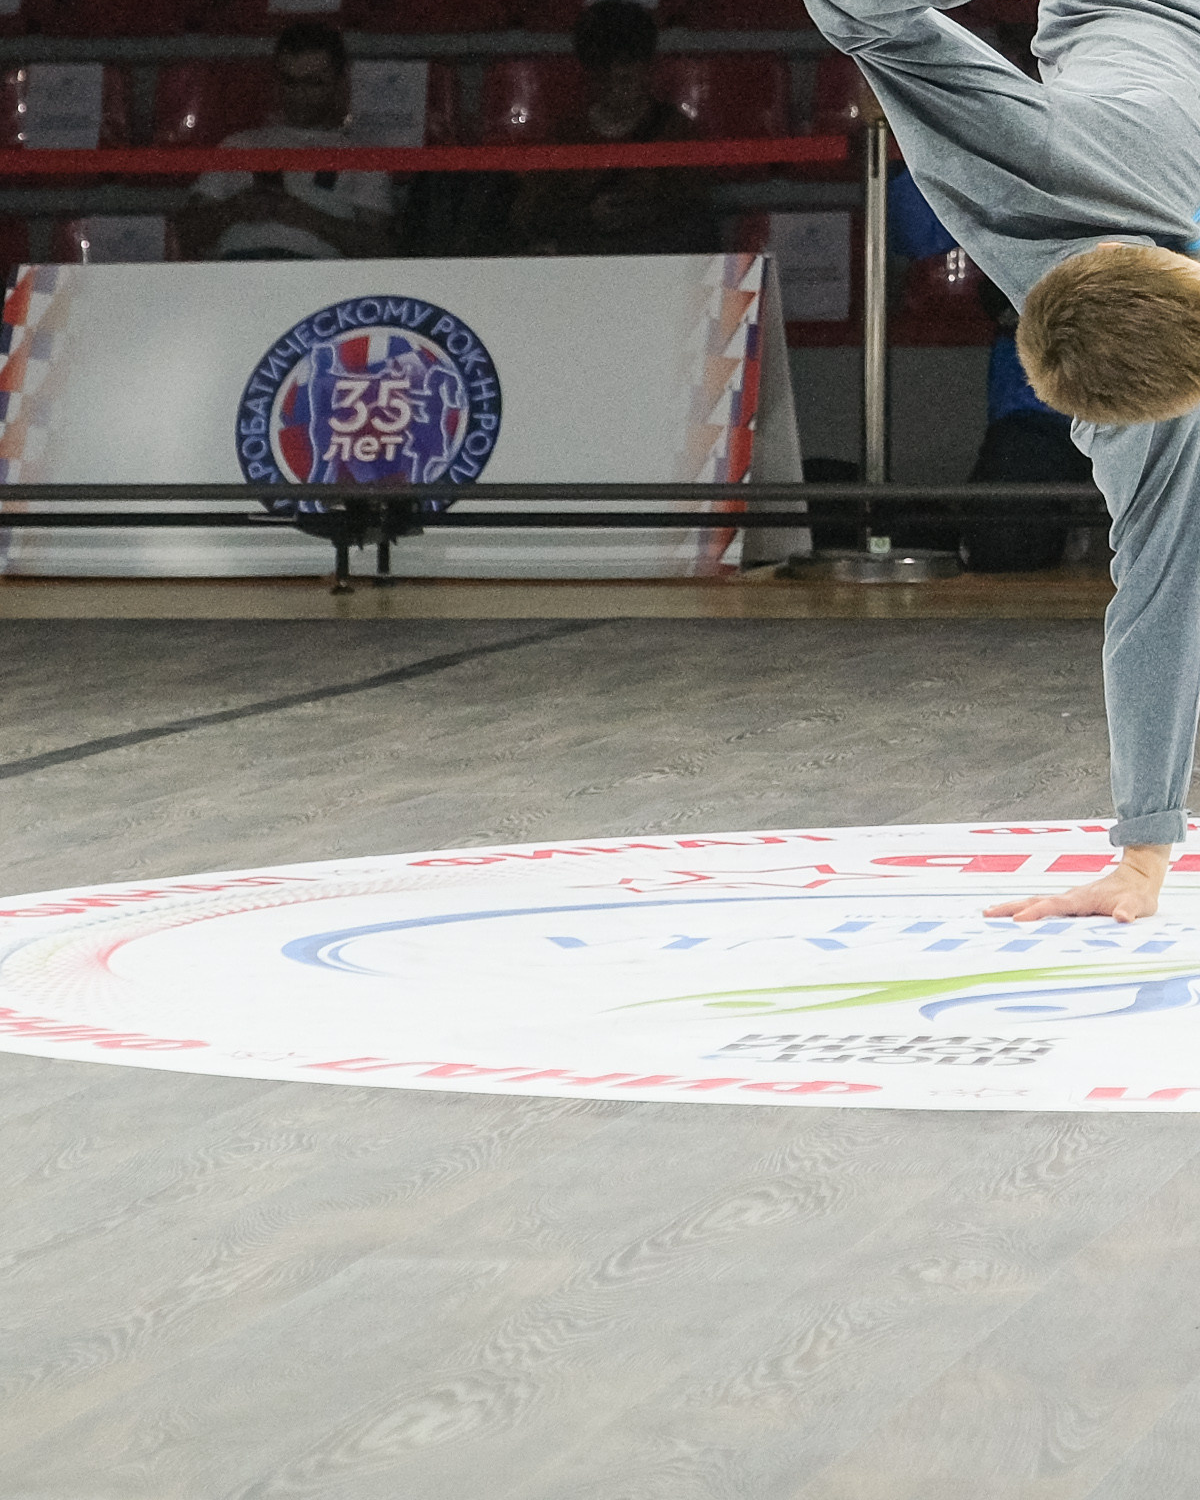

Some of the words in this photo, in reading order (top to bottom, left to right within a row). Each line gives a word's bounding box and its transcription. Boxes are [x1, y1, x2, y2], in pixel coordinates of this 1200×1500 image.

[241, 299, 434, 490] РОБАТИЧЕСКОМУ
[430, 314, 498, 490] РОК-Н-РОЛ
[327, 378, 413, 434] 35
[406, 834, 835, 867] ФИНАЛ
[715, 1043, 1054, 1057] НОРМА
[736, 1034, 1070, 1047] ЖИЗНИ
[298, 1056, 882, 1096] ФИНАЛ
[754, 1054, 1038, 1067] СПОРТ
